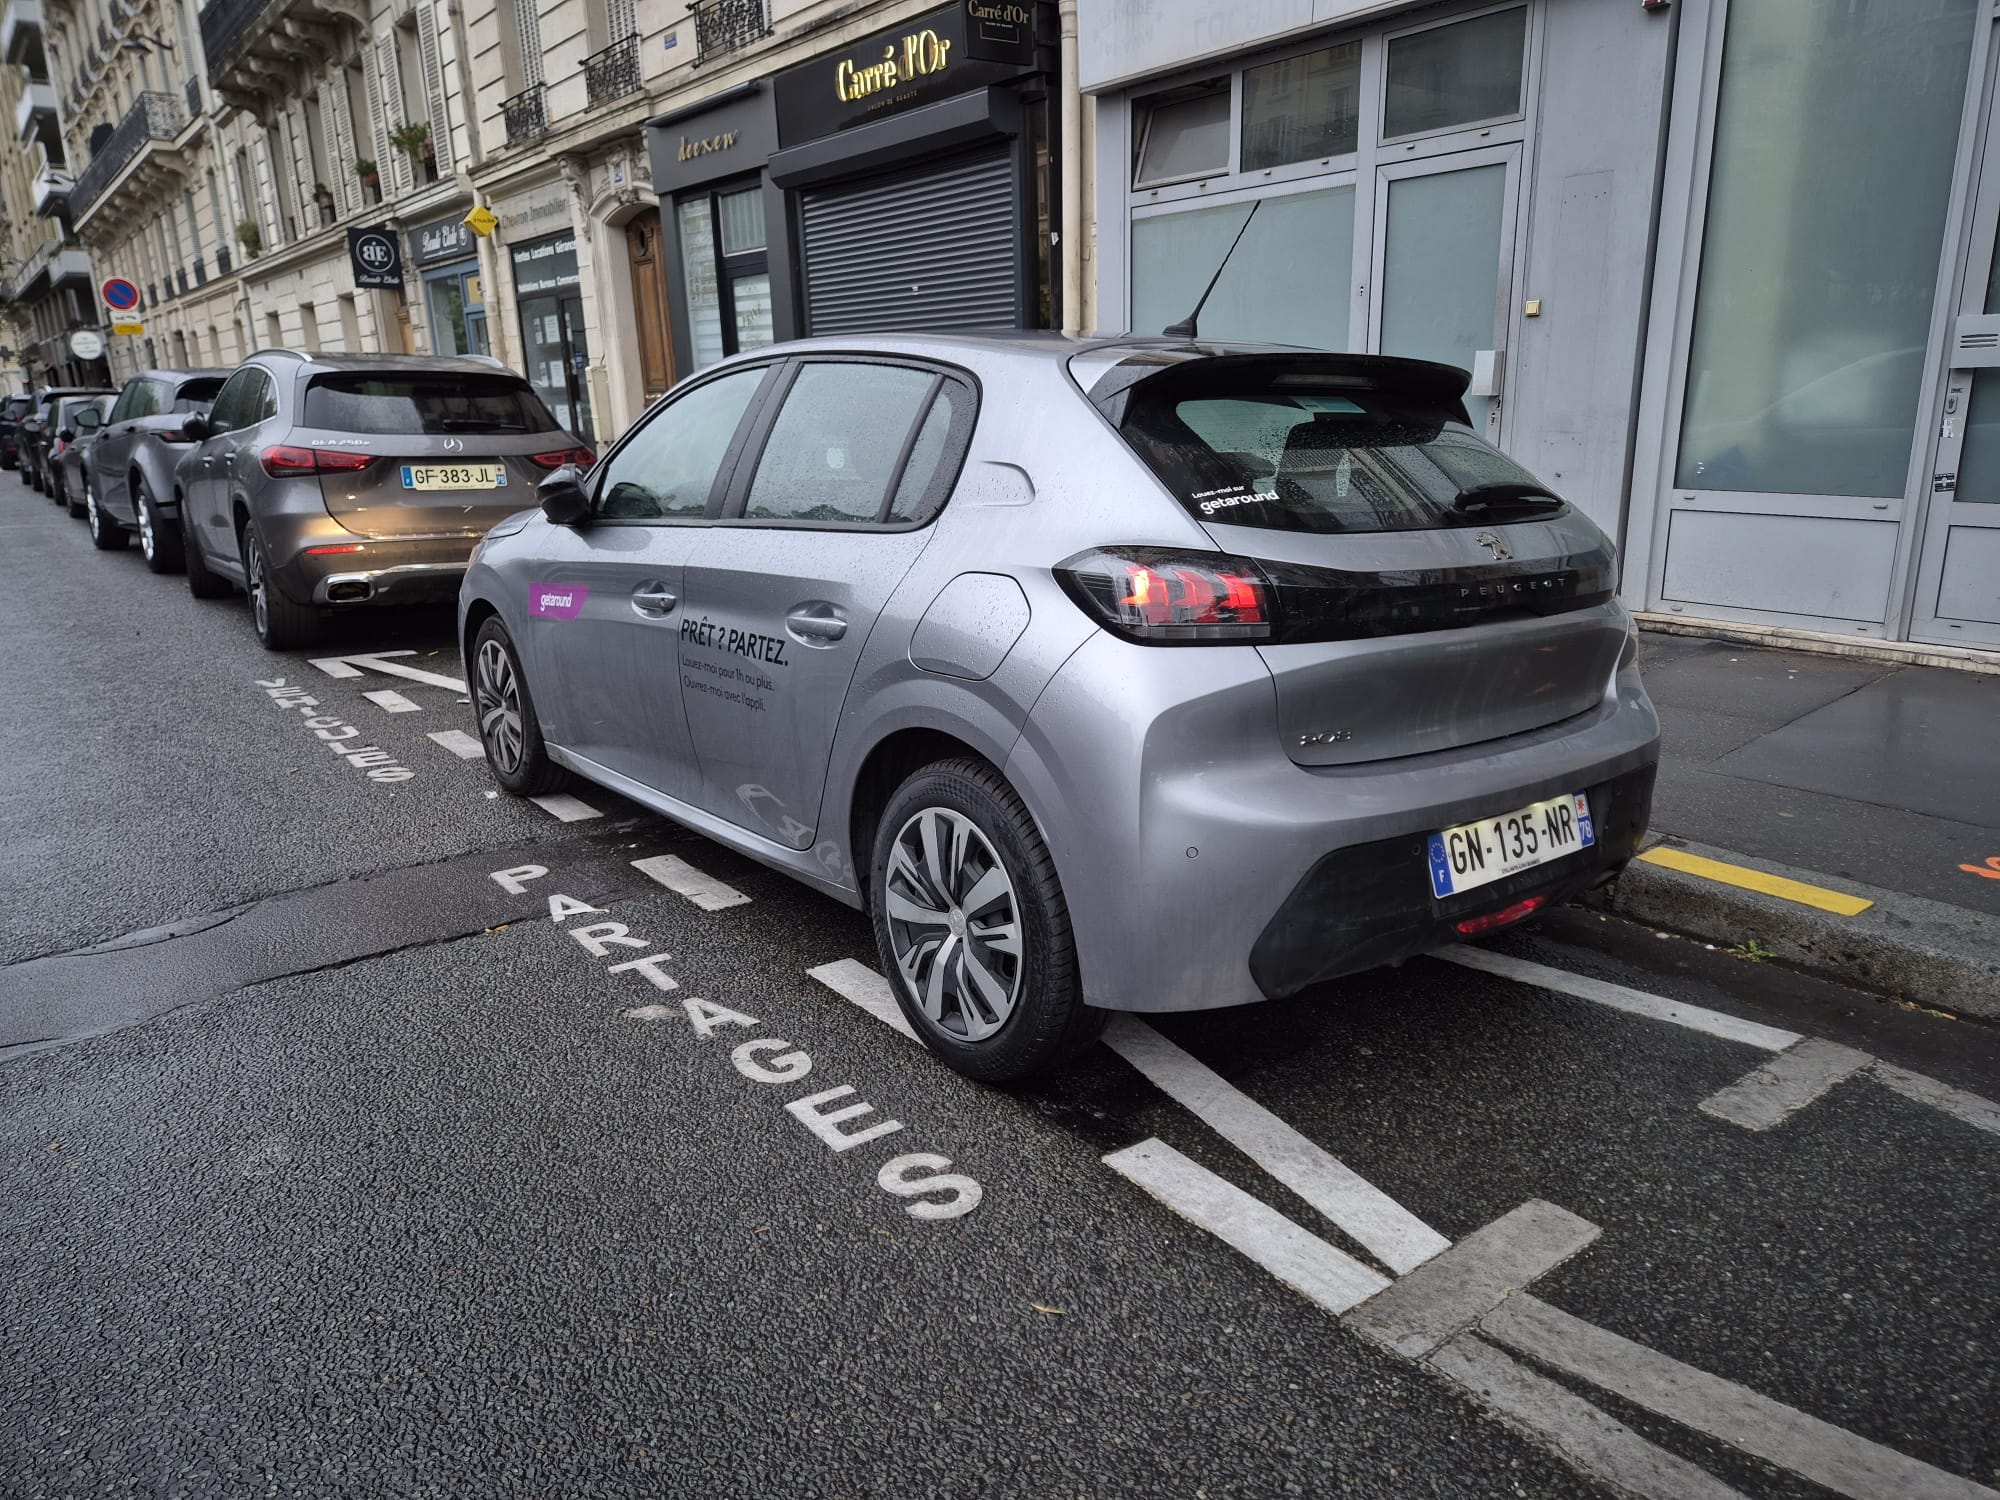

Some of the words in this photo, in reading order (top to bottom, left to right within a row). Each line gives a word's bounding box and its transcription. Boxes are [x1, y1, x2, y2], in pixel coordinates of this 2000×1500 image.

[968, 0, 1002, 20] Carré
[1003, 4, 1029, 24] d'Or
[835, 45, 897, 102] Carré
[898, 29, 951, 81] d'Or
[414, 467, 495, 485] GF-383-JL
[1191, 486, 1233, 499] Louez-moi
[1200, 489, 1280, 515] getaround
[1460, 578, 1566, 598] PEUGEOT
[540, 592, 573, 612] getaround
[681, 616, 716, 648] PRÊT
[718, 627, 726, 651] ?
[727, 629, 789, 667] PARTEZ.
[682, 655, 718, 674] Louez-moi
[718, 666, 735, 680] pour
[745, 674, 756, 686] ou
[756, 675, 775, 692] plus.
[684, 675, 724, 698] Ouvrez-moi
[724, 690, 741, 704] avec
[741, 692, 766, 713] l'appli.
[1449, 803, 1576, 876] GN-135-NR
[1579, 818, 1592, 841] 78
[1438, 869, 1445, 883] F
[489, 864, 984, 1221] PARTAGES
